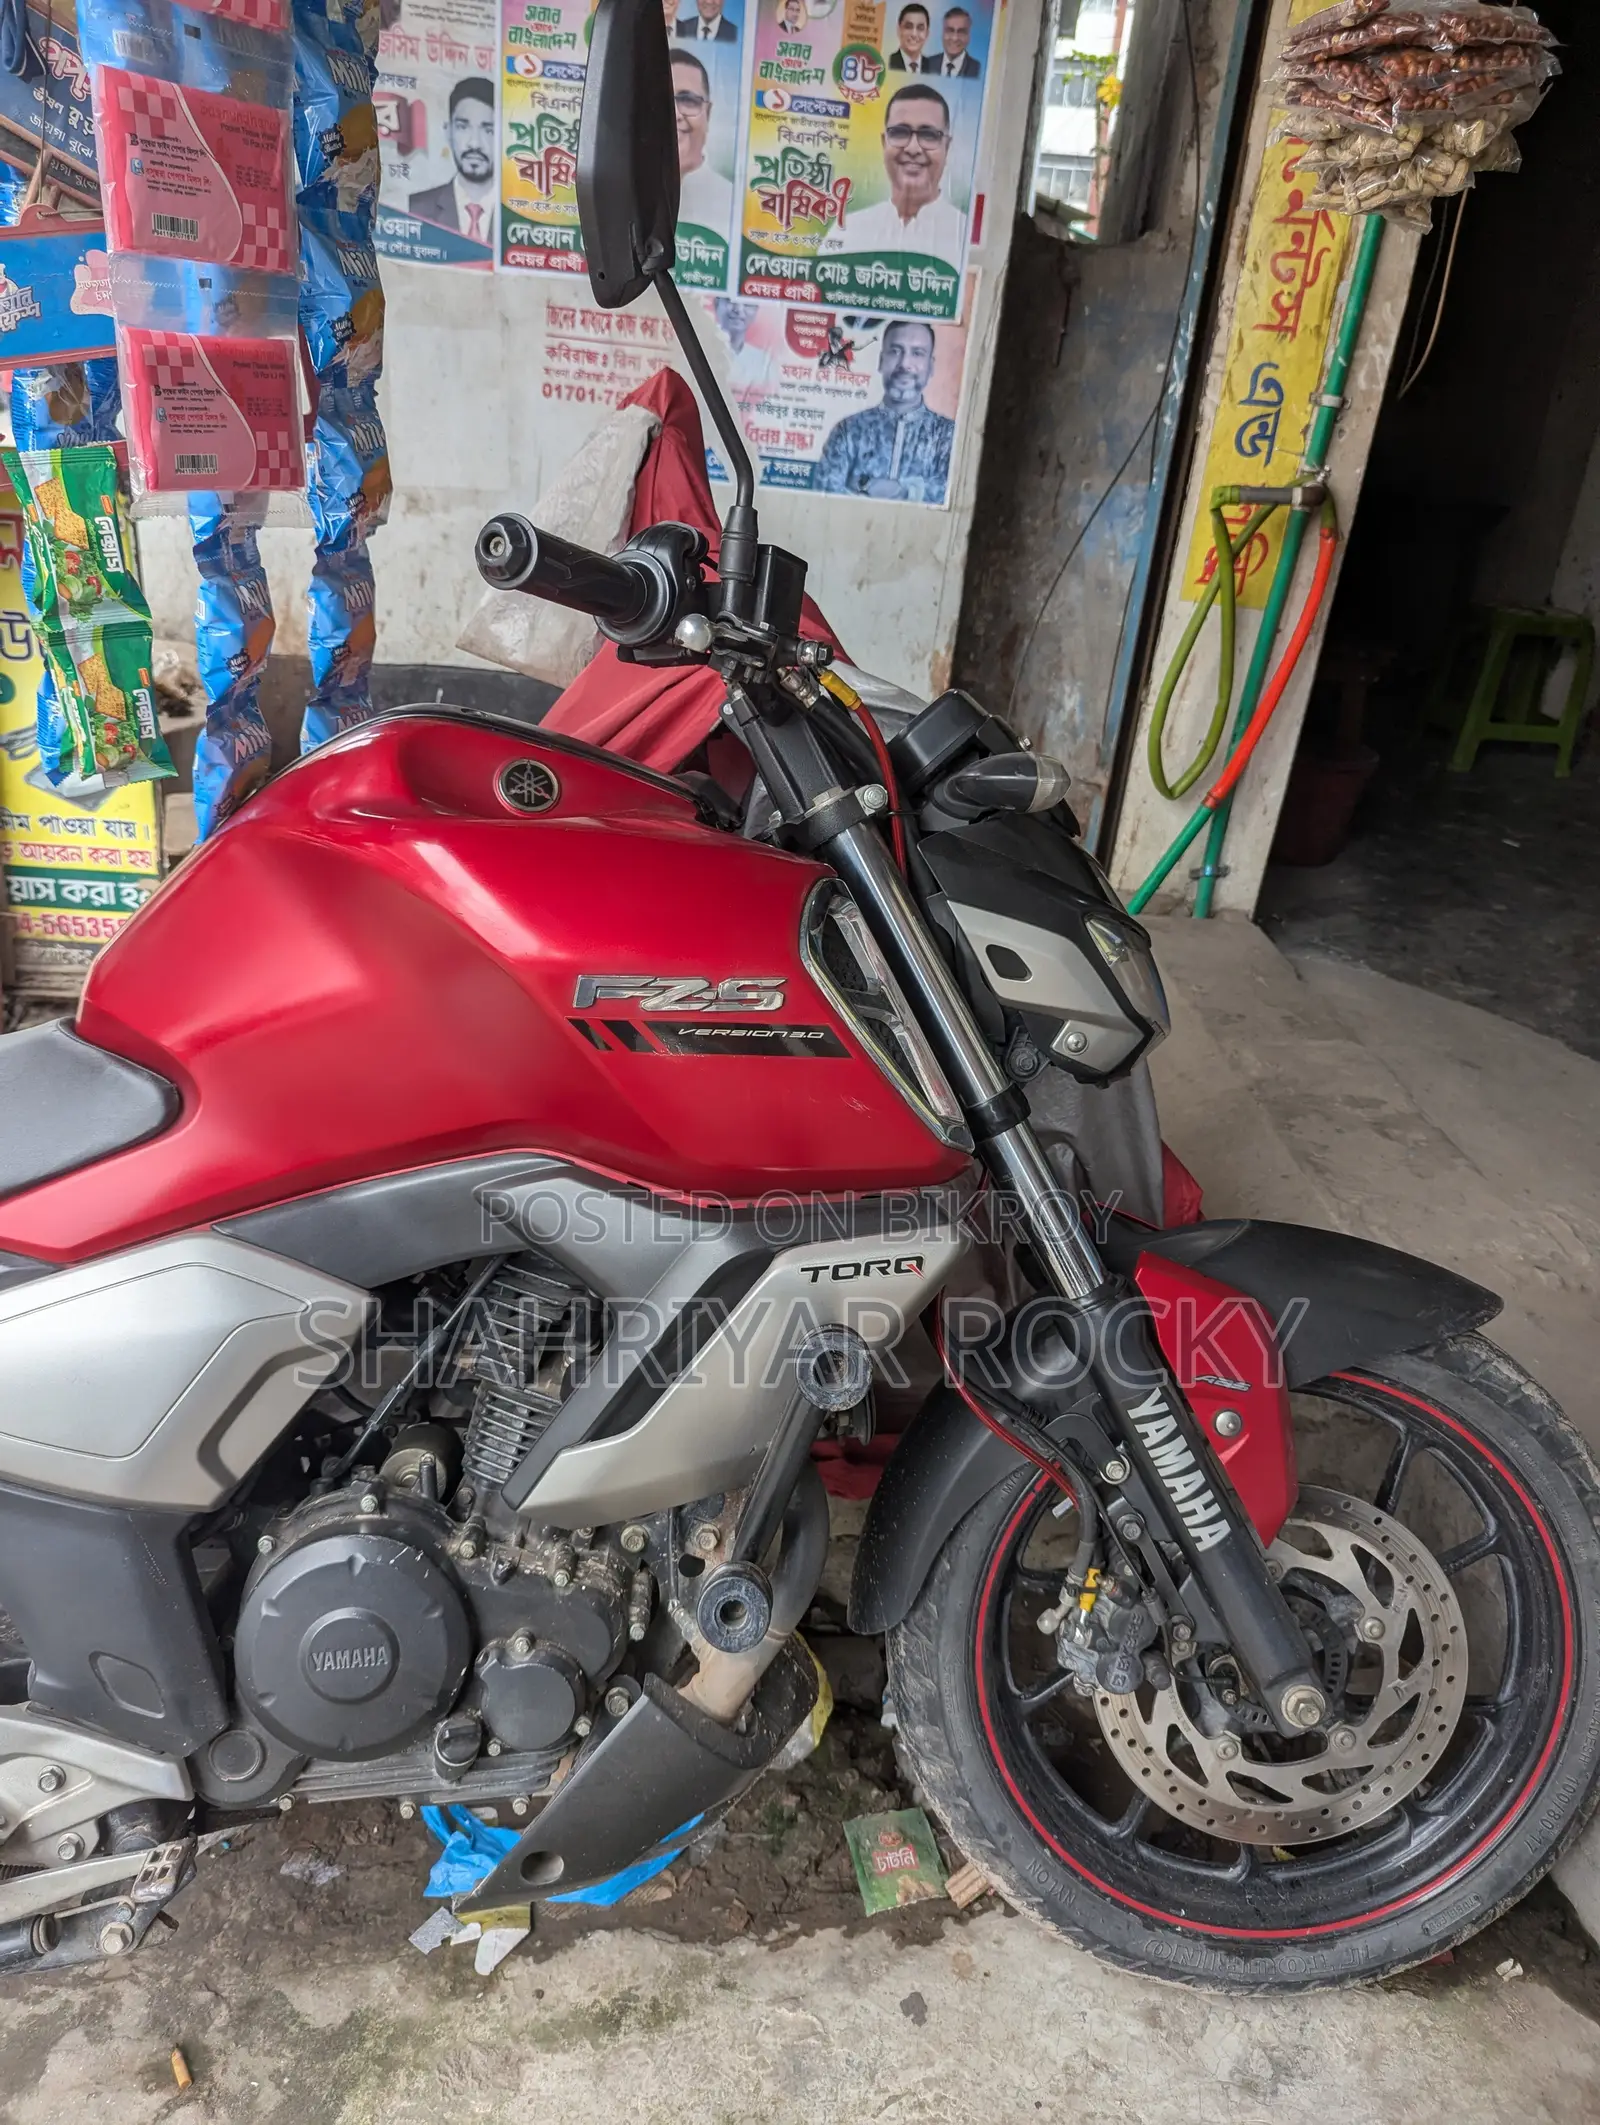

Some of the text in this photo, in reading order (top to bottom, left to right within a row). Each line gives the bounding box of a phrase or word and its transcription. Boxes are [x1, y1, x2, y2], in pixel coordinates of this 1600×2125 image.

[507, 223, 577, 251] দেওয়ান
[746, 253, 813, 280] দেওয়ান
[854, 260, 903, 291] জসিম
[907, 264, 957, 298] উদ্দিন
[744, 281, 782, 299] মেয়র
[39, 815, 96, 837] পাওয়া
[103, 820, 136, 839] যায়
[88, 847, 122, 867] করা
[7, 875, 57, 903] য়াস
[59, 879, 117, 907] করা
[677, 1027, 825, 1040] VERSION 3.0
[800, 1254, 926, 1286] TORQ
[1127, 1386, 1233, 1552] YAMAHA
[310, 1645, 389, 1672] YAMAHA
[874, 1847, 915, 1873] চাটনি
